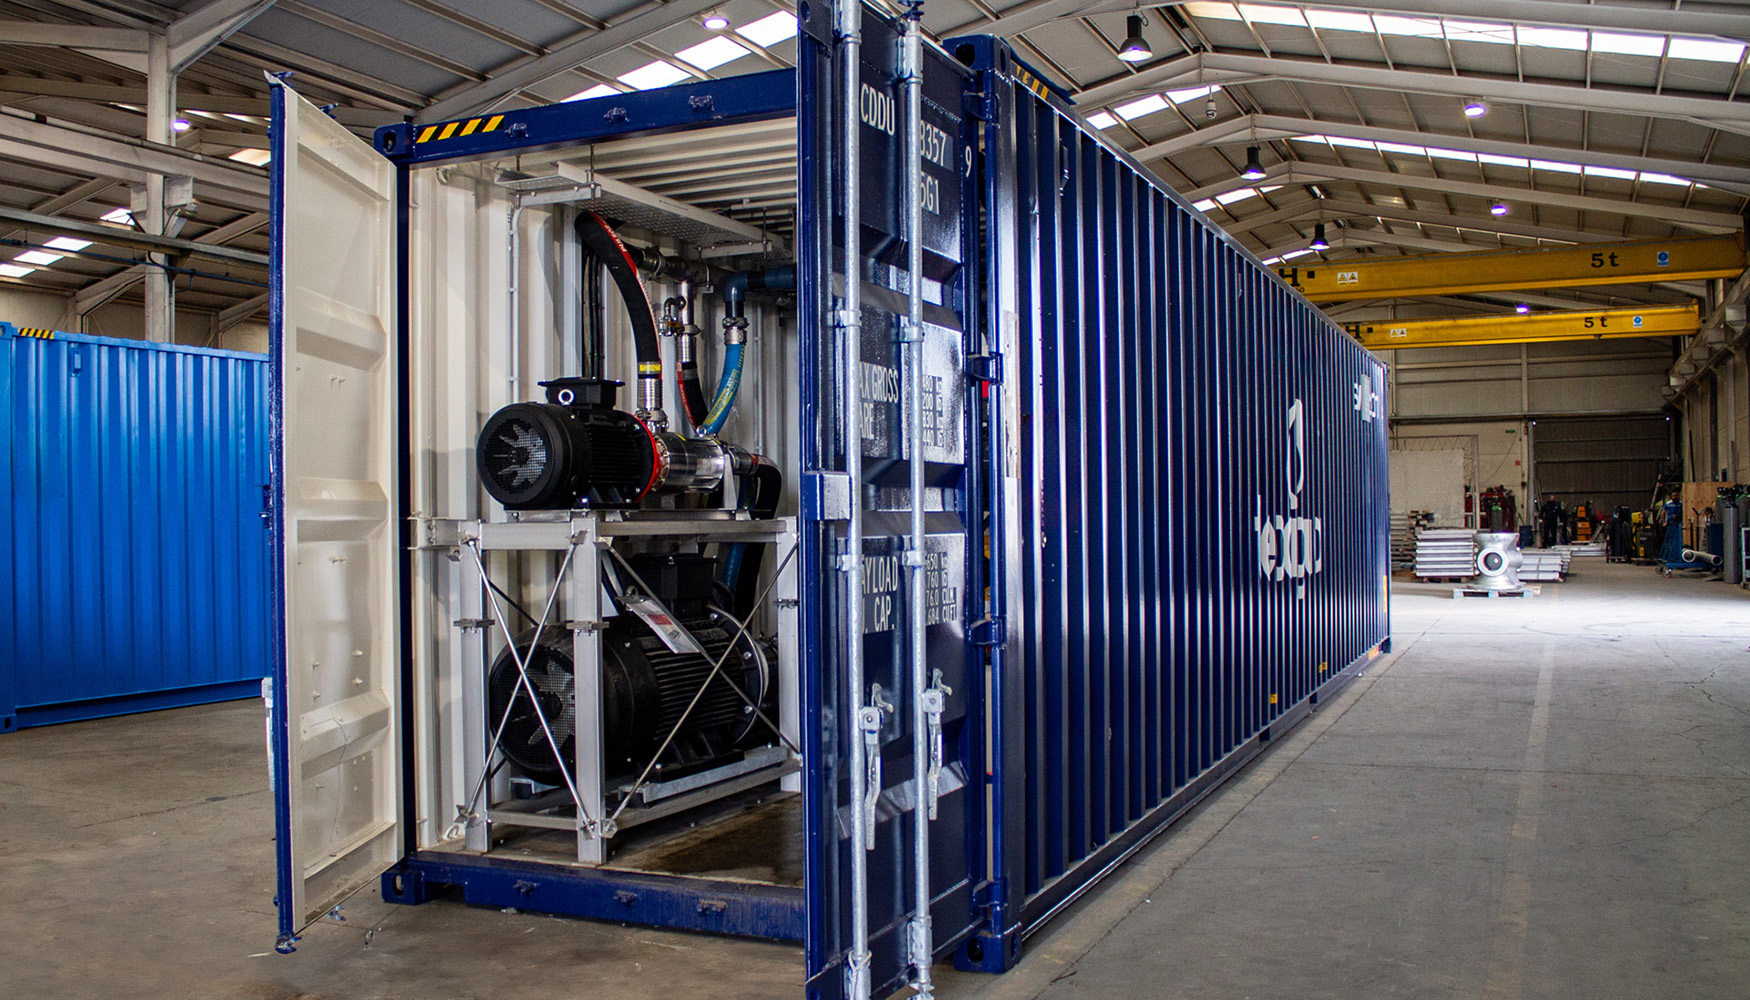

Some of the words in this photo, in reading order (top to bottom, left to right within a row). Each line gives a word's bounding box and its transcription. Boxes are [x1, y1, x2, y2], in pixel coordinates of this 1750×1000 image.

[860, 83, 895, 136] CDDU
[965, 145, 972, 178] 9
[920, 170, 940, 215] 5G1
[1591, 252, 1605, 268] 5
[1608, 251, 1619, 267] t
[1584, 316, 1595, 328] 5
[1600, 316, 1608, 328] t
[859, 361, 871, 399] AX
[872, 364, 899, 404] GROSS
[859, 402, 875, 440] ARE
[861, 556, 899, 595] AYLOAD
